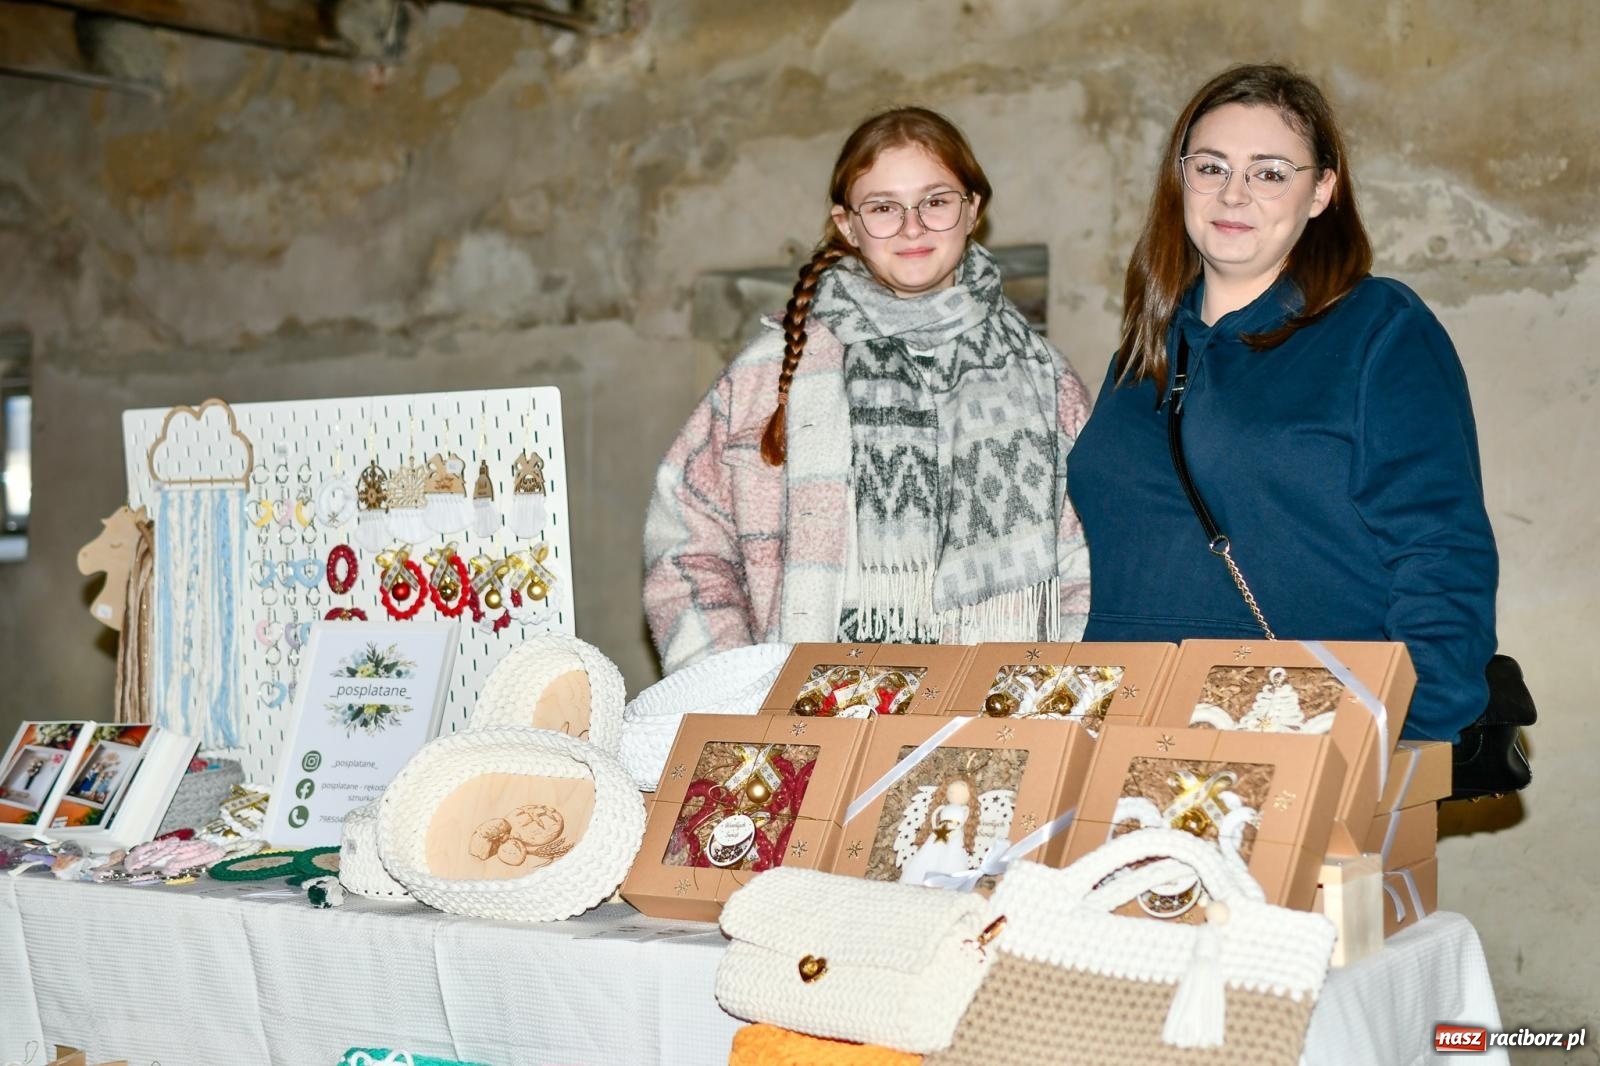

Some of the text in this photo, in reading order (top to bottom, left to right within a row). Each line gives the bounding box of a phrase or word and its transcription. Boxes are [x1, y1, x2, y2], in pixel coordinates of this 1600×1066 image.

[329, 683, 412, 700] _posplatane_
[331, 759, 379, 770] _posplatane_
[321, 782, 359, 791] posplatane
